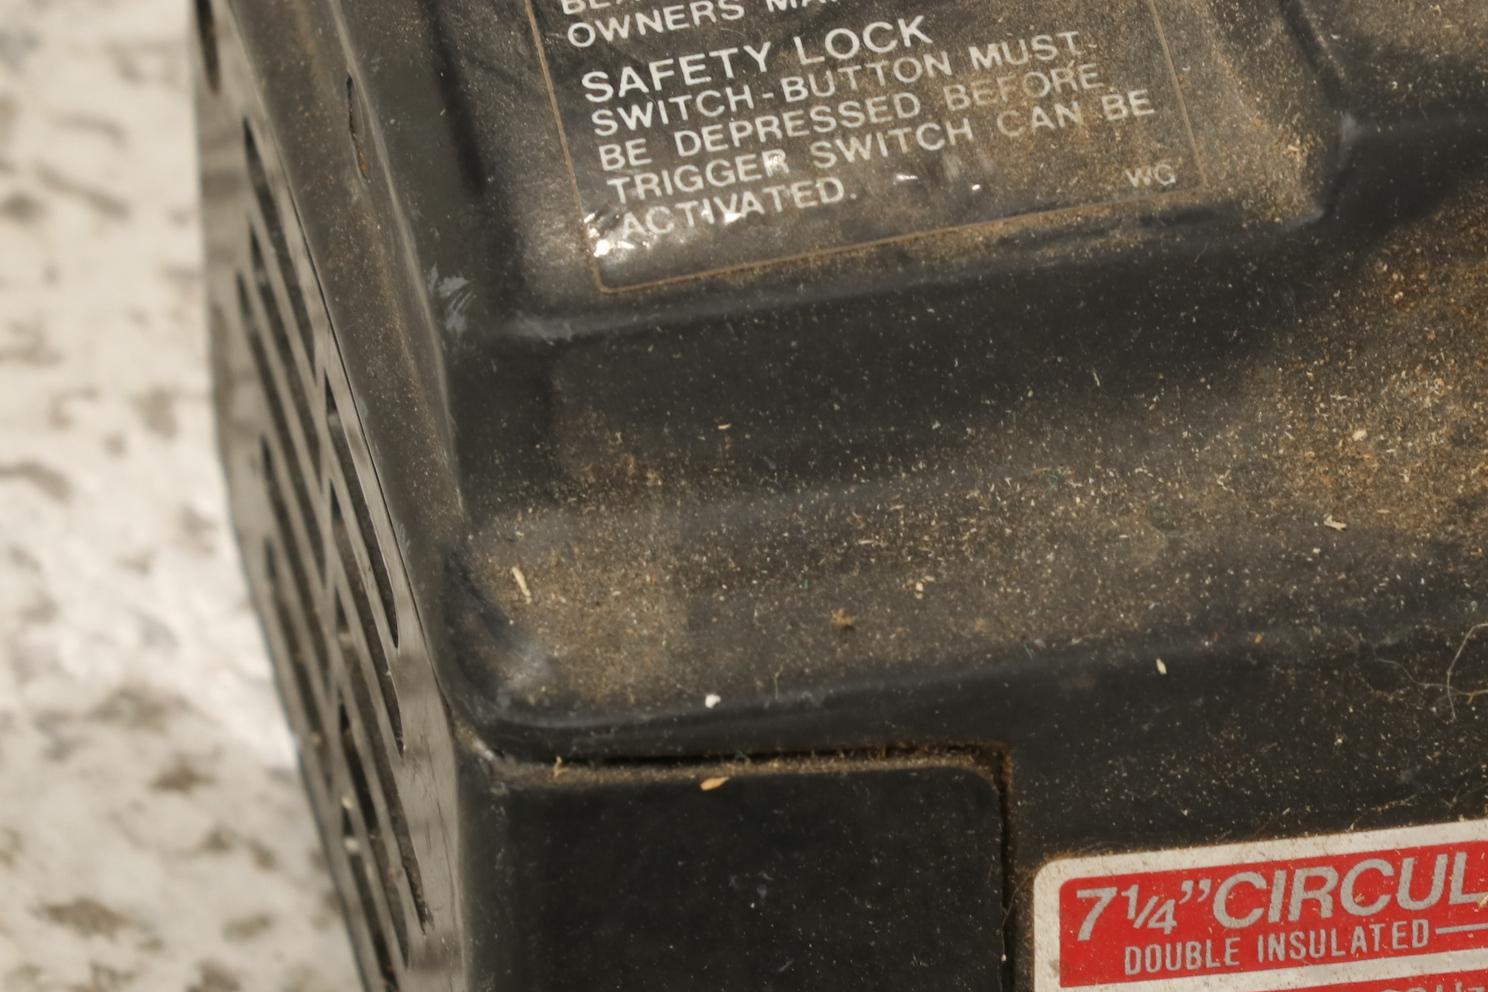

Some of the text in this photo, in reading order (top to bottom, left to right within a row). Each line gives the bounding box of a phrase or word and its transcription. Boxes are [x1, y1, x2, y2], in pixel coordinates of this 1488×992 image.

[568, 0, 745, 47] OWNERS
[968, 31, 1082, 71] MUST
[582, 15, 934, 102] SAFETY LOCK
[598, 63, 1104, 171] BE DEPRESSED BEFORE
[607, 89, 1155, 204] TRIGGER SWITCH CAN BE
[622, 176, 858, 240] ACTIVATED.
[1124, 936, 1242, 977] DOUBLE
[1257, 918, 1430, 963] INSULATED
